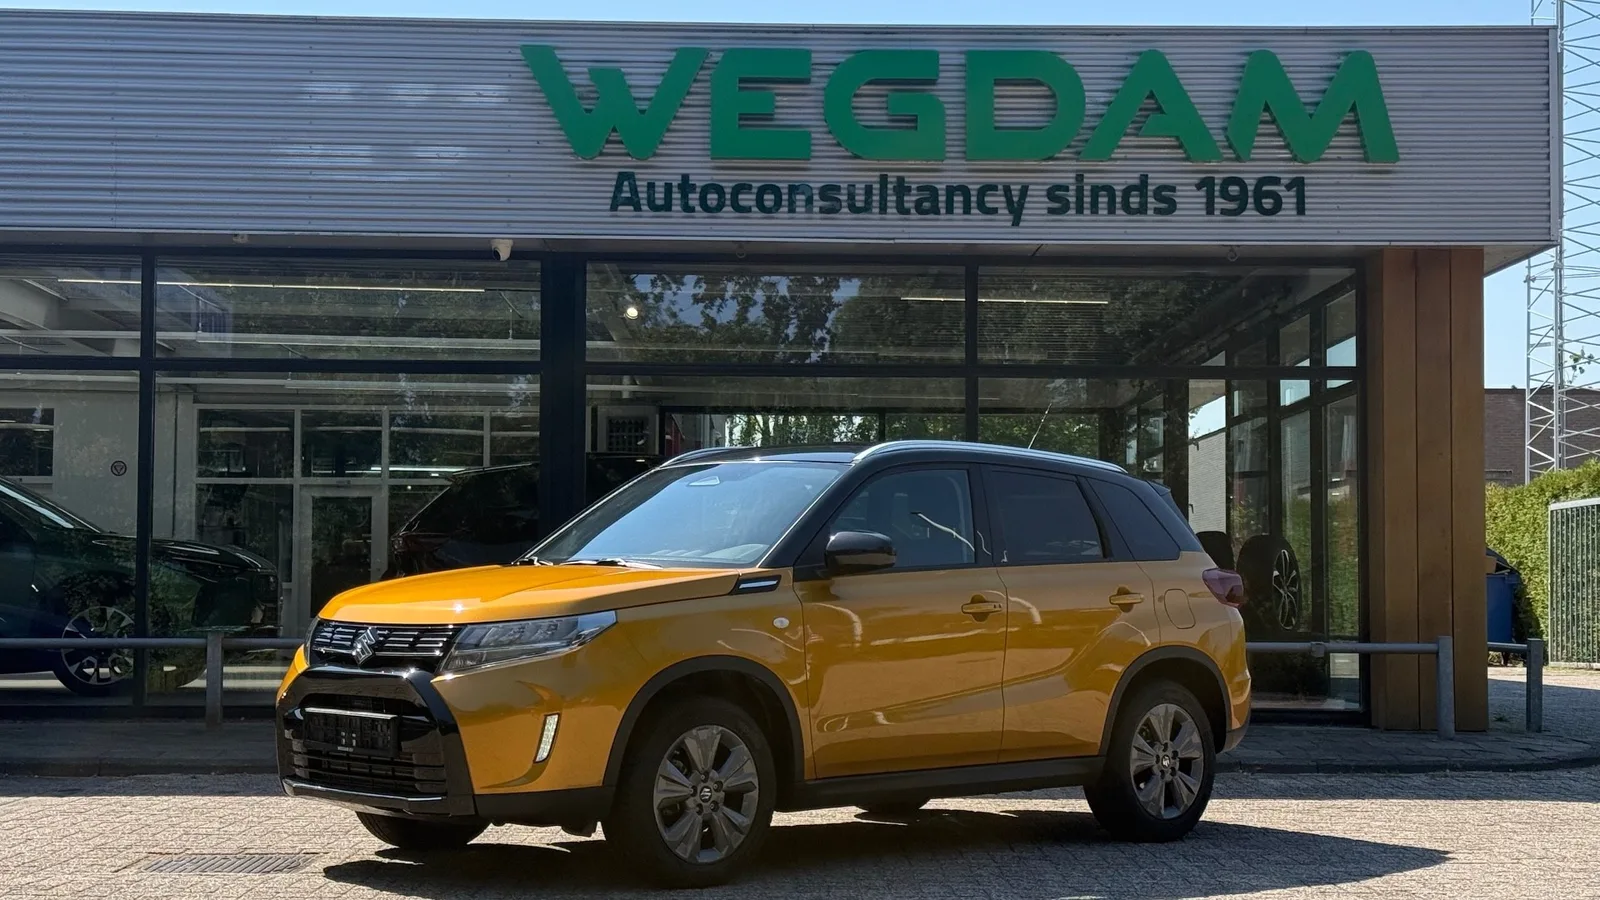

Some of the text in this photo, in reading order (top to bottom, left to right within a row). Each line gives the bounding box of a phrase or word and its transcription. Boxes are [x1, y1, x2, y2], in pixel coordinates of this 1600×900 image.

[520, 44, 1399, 164] WEGDAM
[609, 171, 1306, 227] Autoconsultancy sinds 1961
